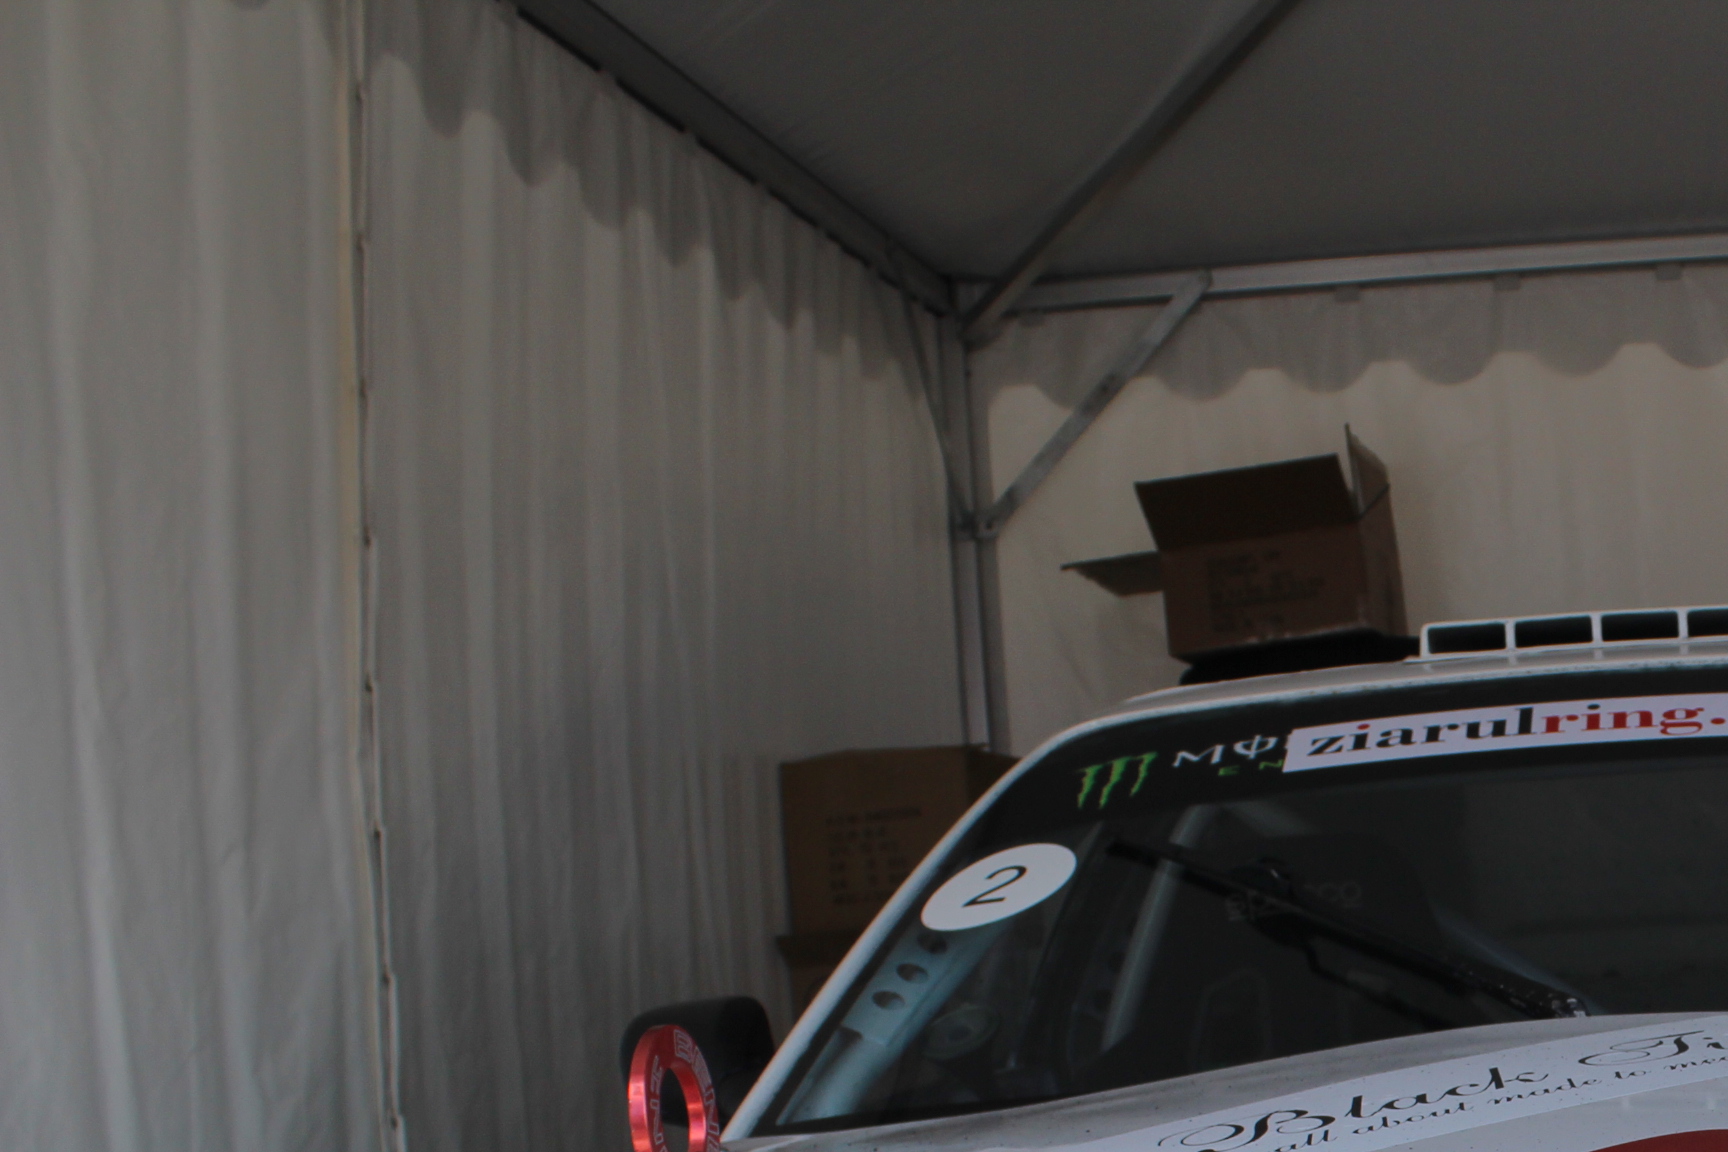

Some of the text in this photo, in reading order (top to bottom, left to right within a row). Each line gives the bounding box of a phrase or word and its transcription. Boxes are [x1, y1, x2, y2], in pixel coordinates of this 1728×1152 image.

[961, 864, 1028, 909] 2
[1351, 1101, 1475, 1135] about
[1486, 1077, 1603, 1106] made
[1613, 1069, 1650, 1081] to
